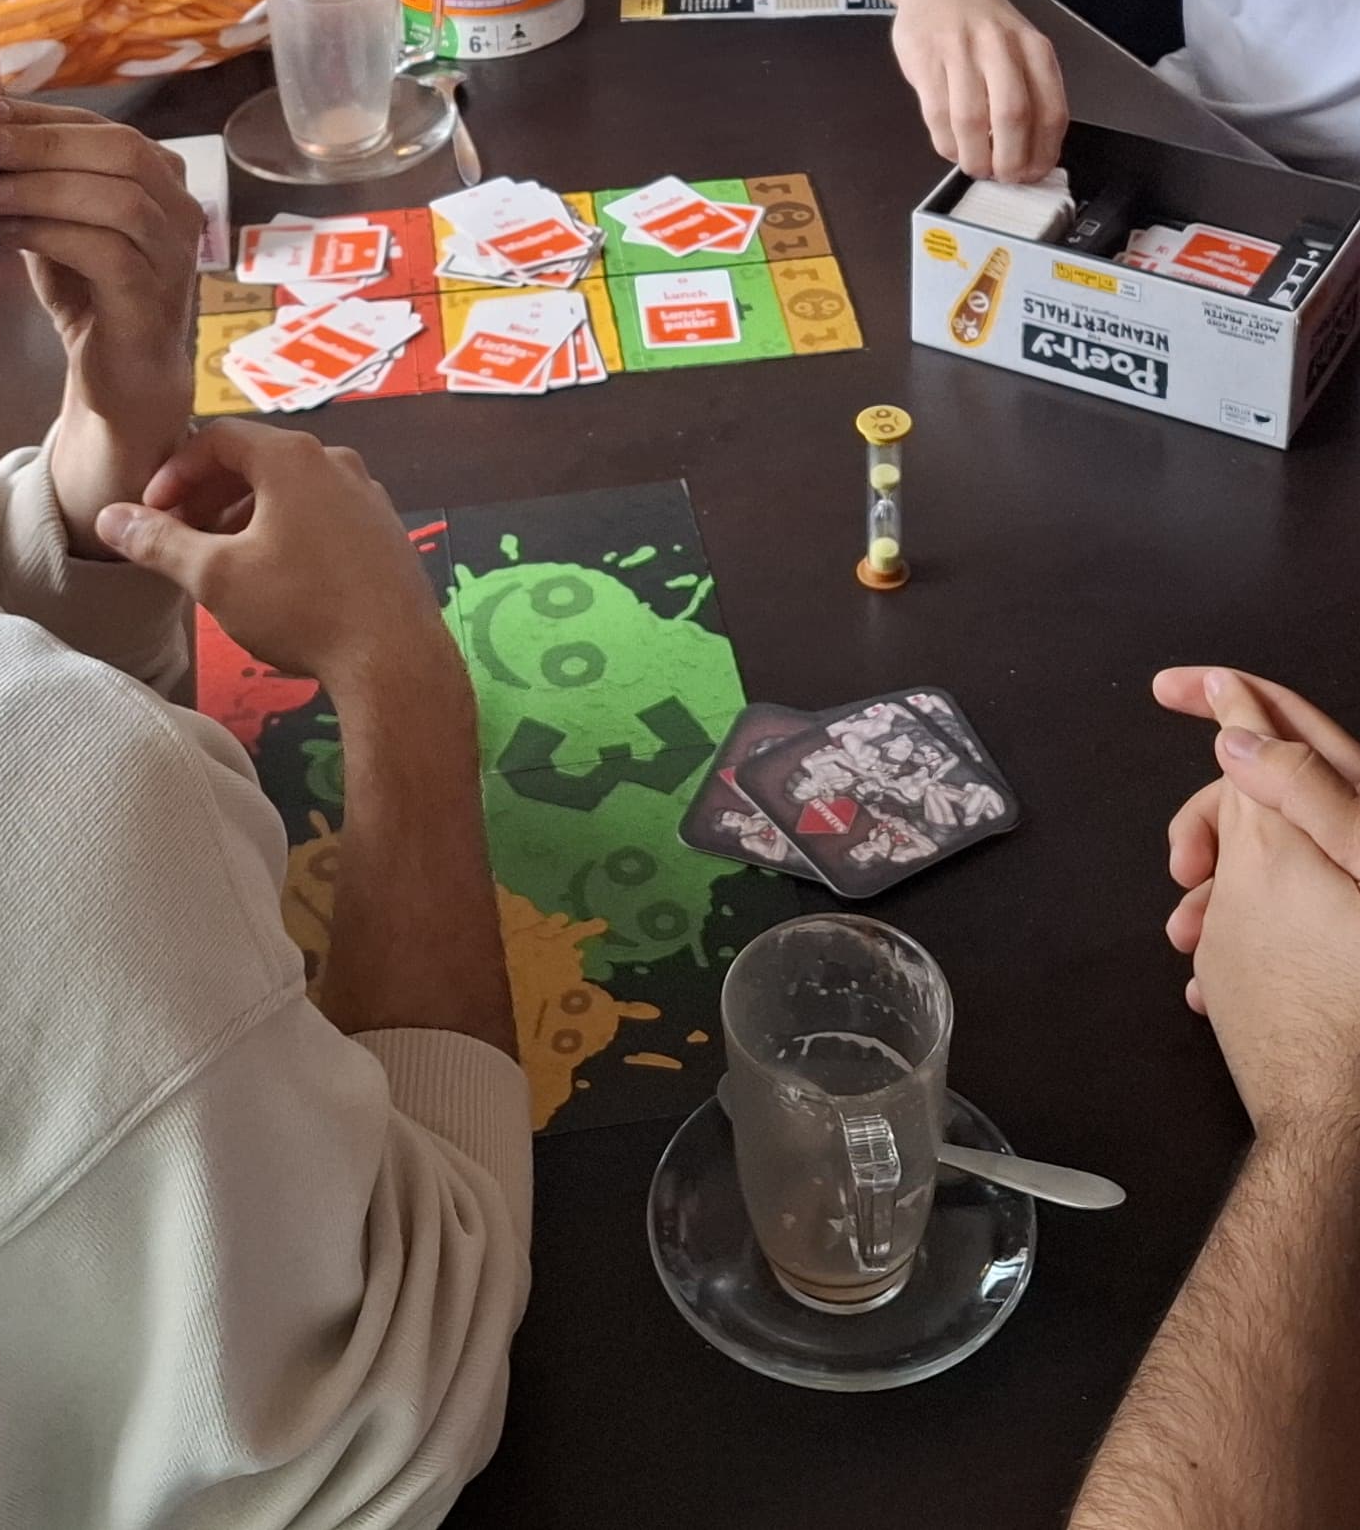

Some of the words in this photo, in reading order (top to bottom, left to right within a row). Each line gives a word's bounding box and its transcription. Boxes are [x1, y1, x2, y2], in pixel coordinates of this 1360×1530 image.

[469, 36, 491, 54] 6+
[663, 290, 708, 301] Lunch
[1023, 297, 1170, 353] NEANDERTHALS
[1203, 308, 1243, 325] PRATEN
[1246, 319, 1280, 334] MOET
[1031, 332, 1159, 395] Poetry
